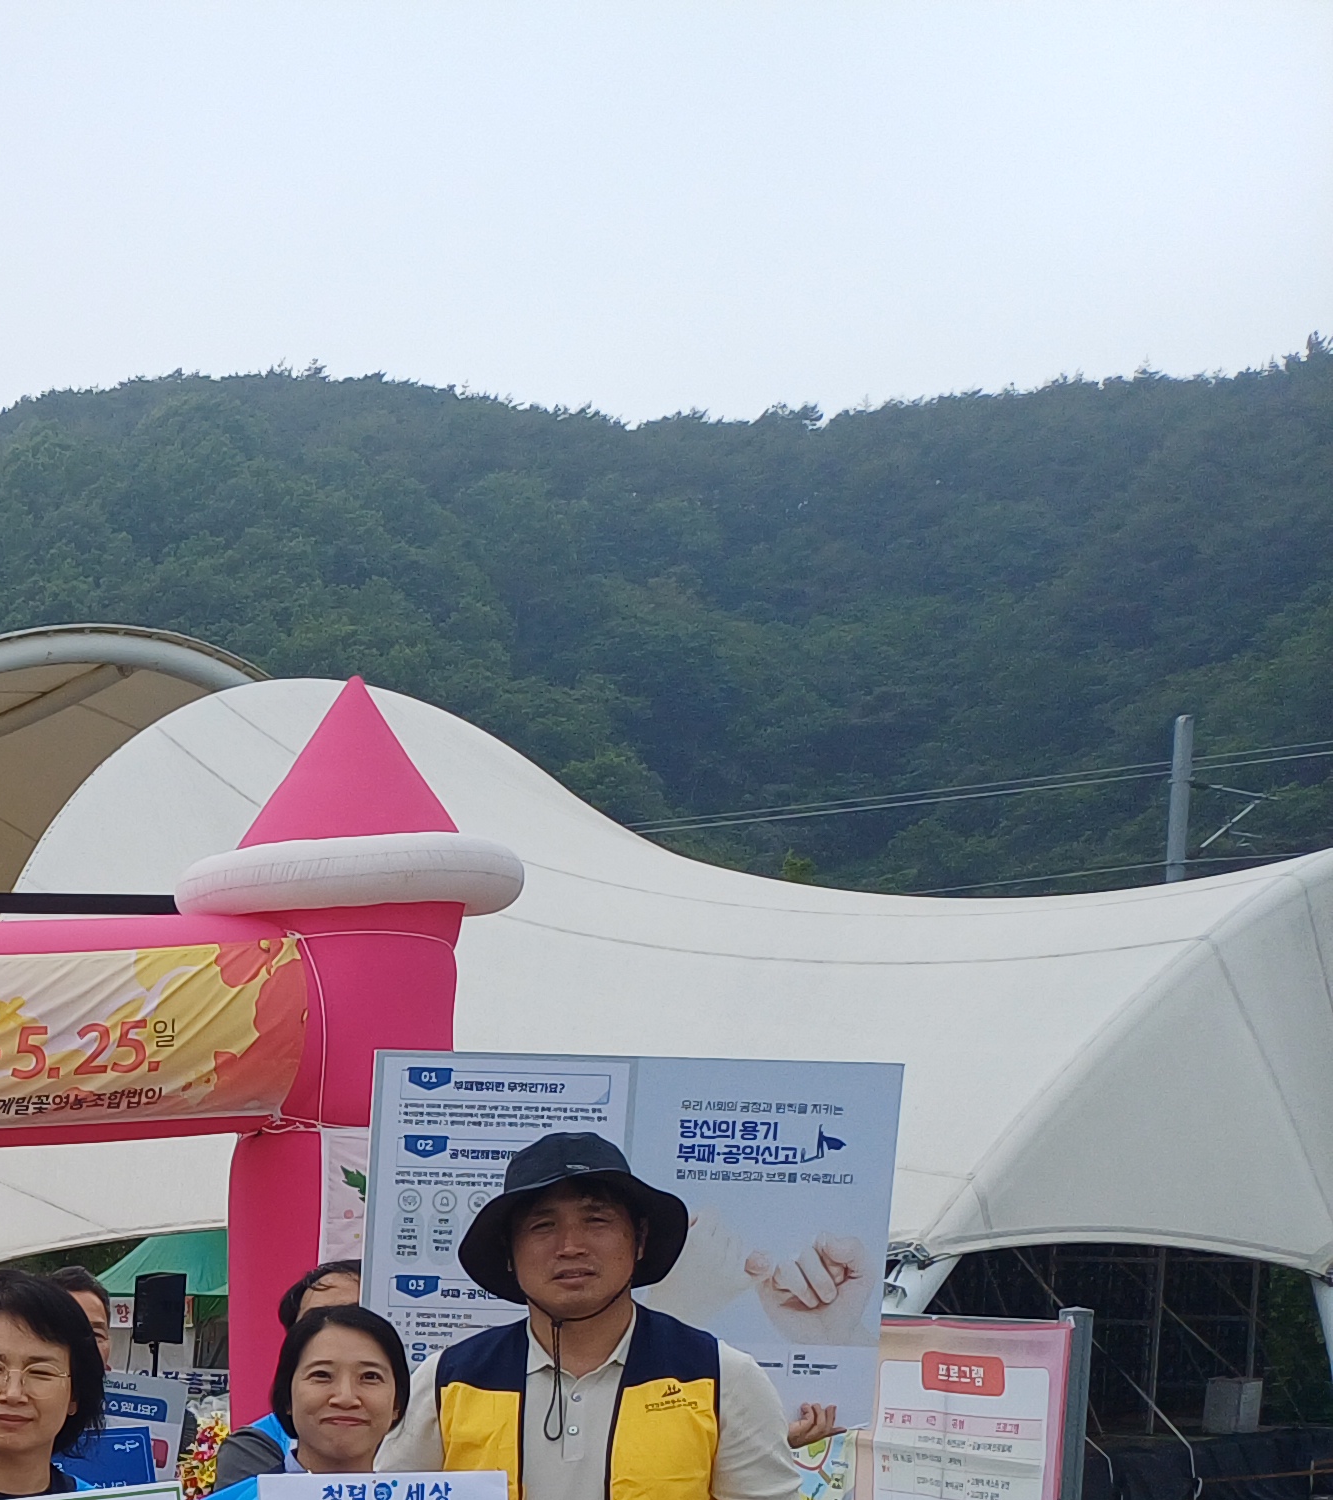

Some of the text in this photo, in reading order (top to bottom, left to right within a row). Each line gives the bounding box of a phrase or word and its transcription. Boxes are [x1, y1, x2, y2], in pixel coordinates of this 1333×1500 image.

[420, 1071, 438, 1084] 01
[680, 1099, 703, 1112] 우리
[810, 1103, 845, 1116] 지키는
[679, 1118, 779, 1142] 당신의 용기
[415, 1139, 434, 1151] 02
[676, 1142, 799, 1165] 부패·공익신고
[408, 1279, 425, 1291] 03
[937, 1363, 984, 1387] 프로그램
